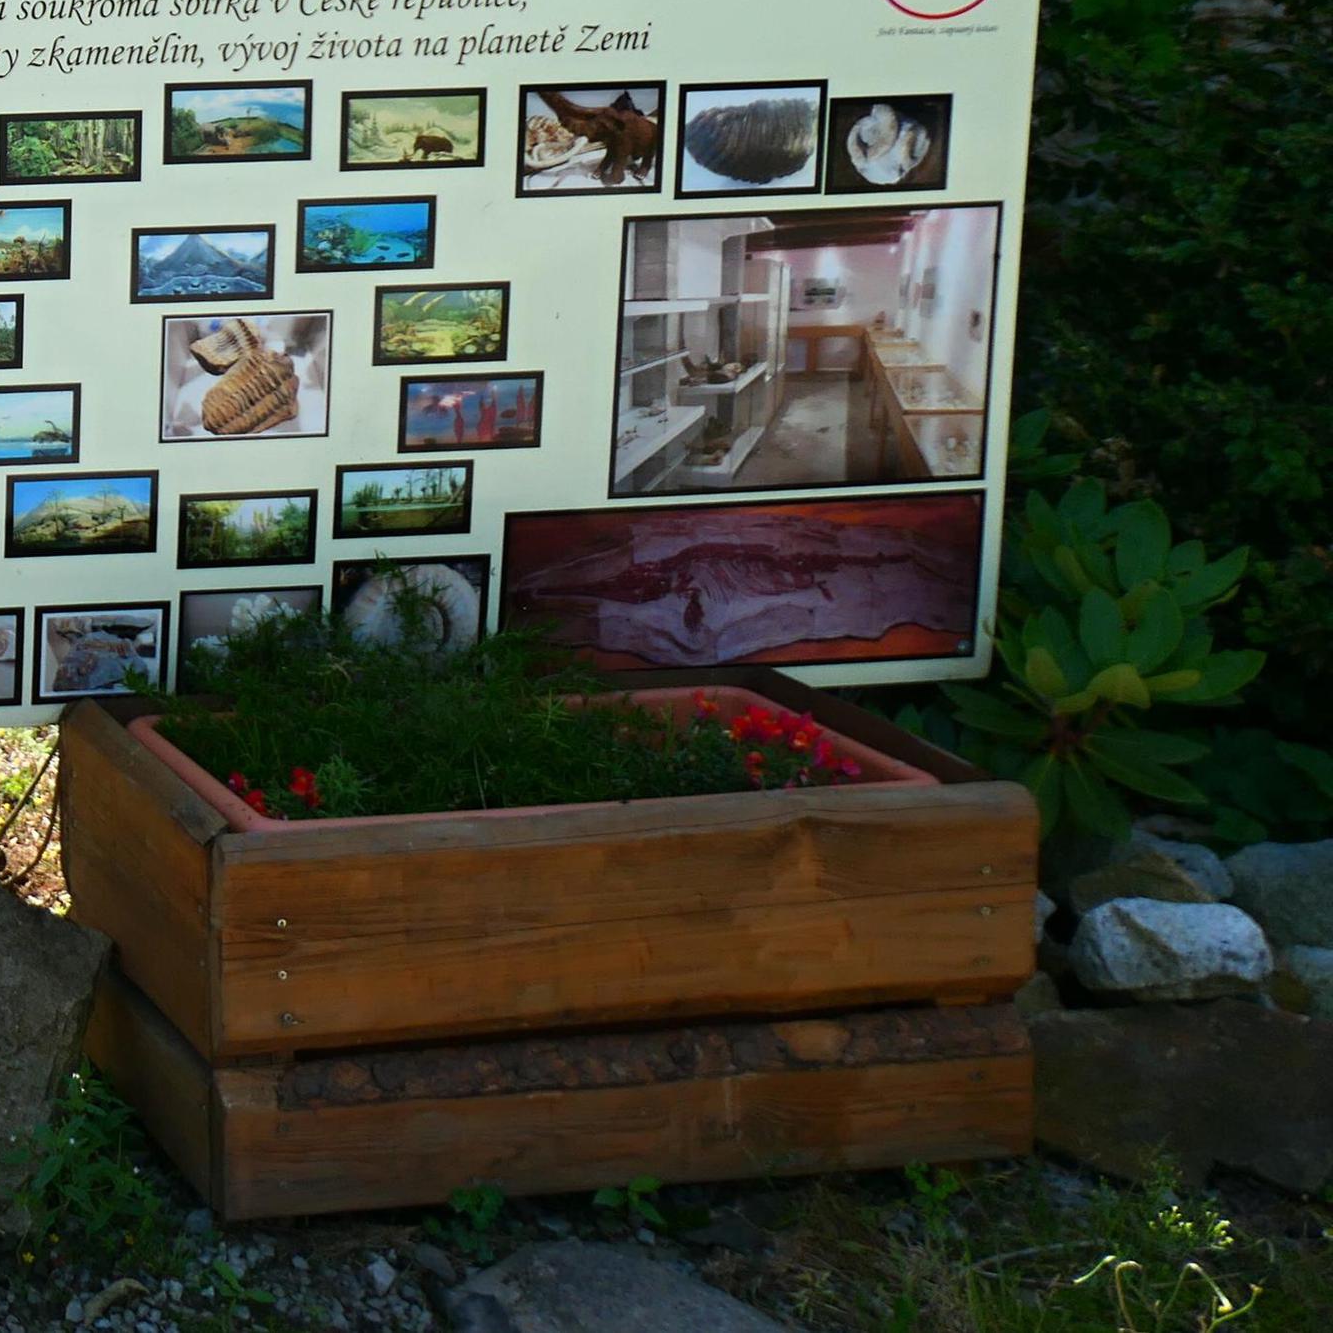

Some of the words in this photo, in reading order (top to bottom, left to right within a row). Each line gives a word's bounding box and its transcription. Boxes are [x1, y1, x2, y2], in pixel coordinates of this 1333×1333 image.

[26, 32, 205, 75] zkamenělin,
[217, 31, 302, 72] vývoj
[306, 29, 403, 60] života
[412, 33, 449, 57] na
[454, 23, 570, 65] planetě
[573, 21, 653, 53] Zemi
